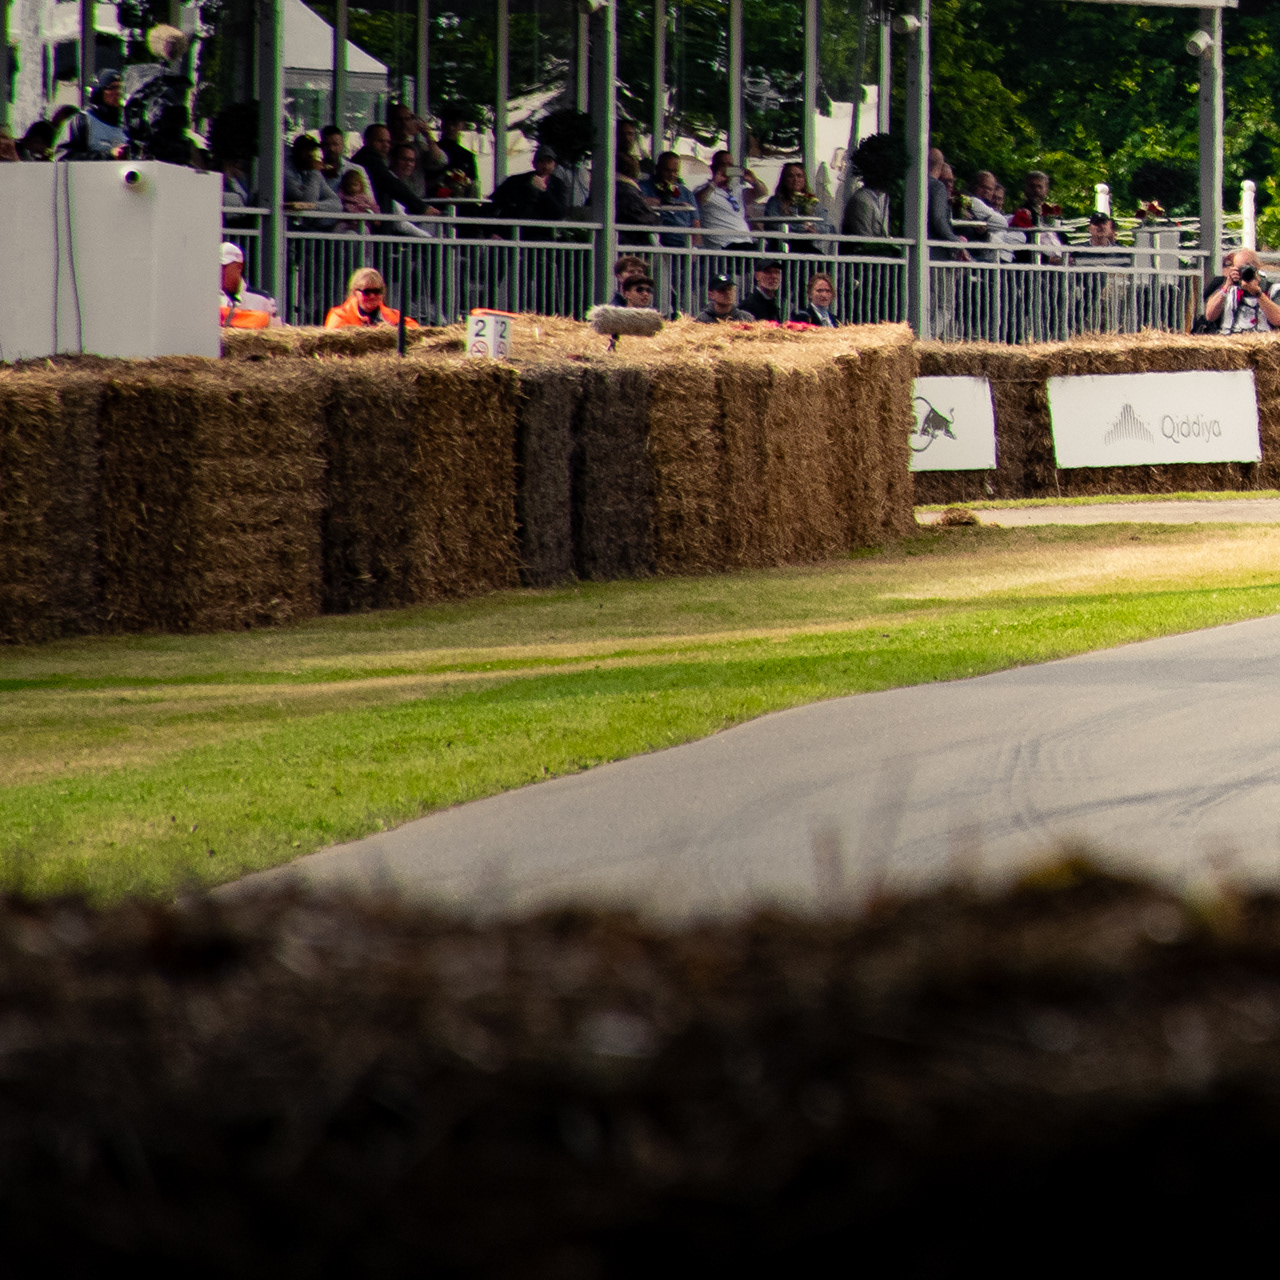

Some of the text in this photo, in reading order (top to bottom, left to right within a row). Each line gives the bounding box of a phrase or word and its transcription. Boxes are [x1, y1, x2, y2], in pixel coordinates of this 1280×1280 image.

[475, 319, 487, 338] 2
[499, 320, 507, 339] 2
[1161, 413, 1222, 444] Qiddiya
